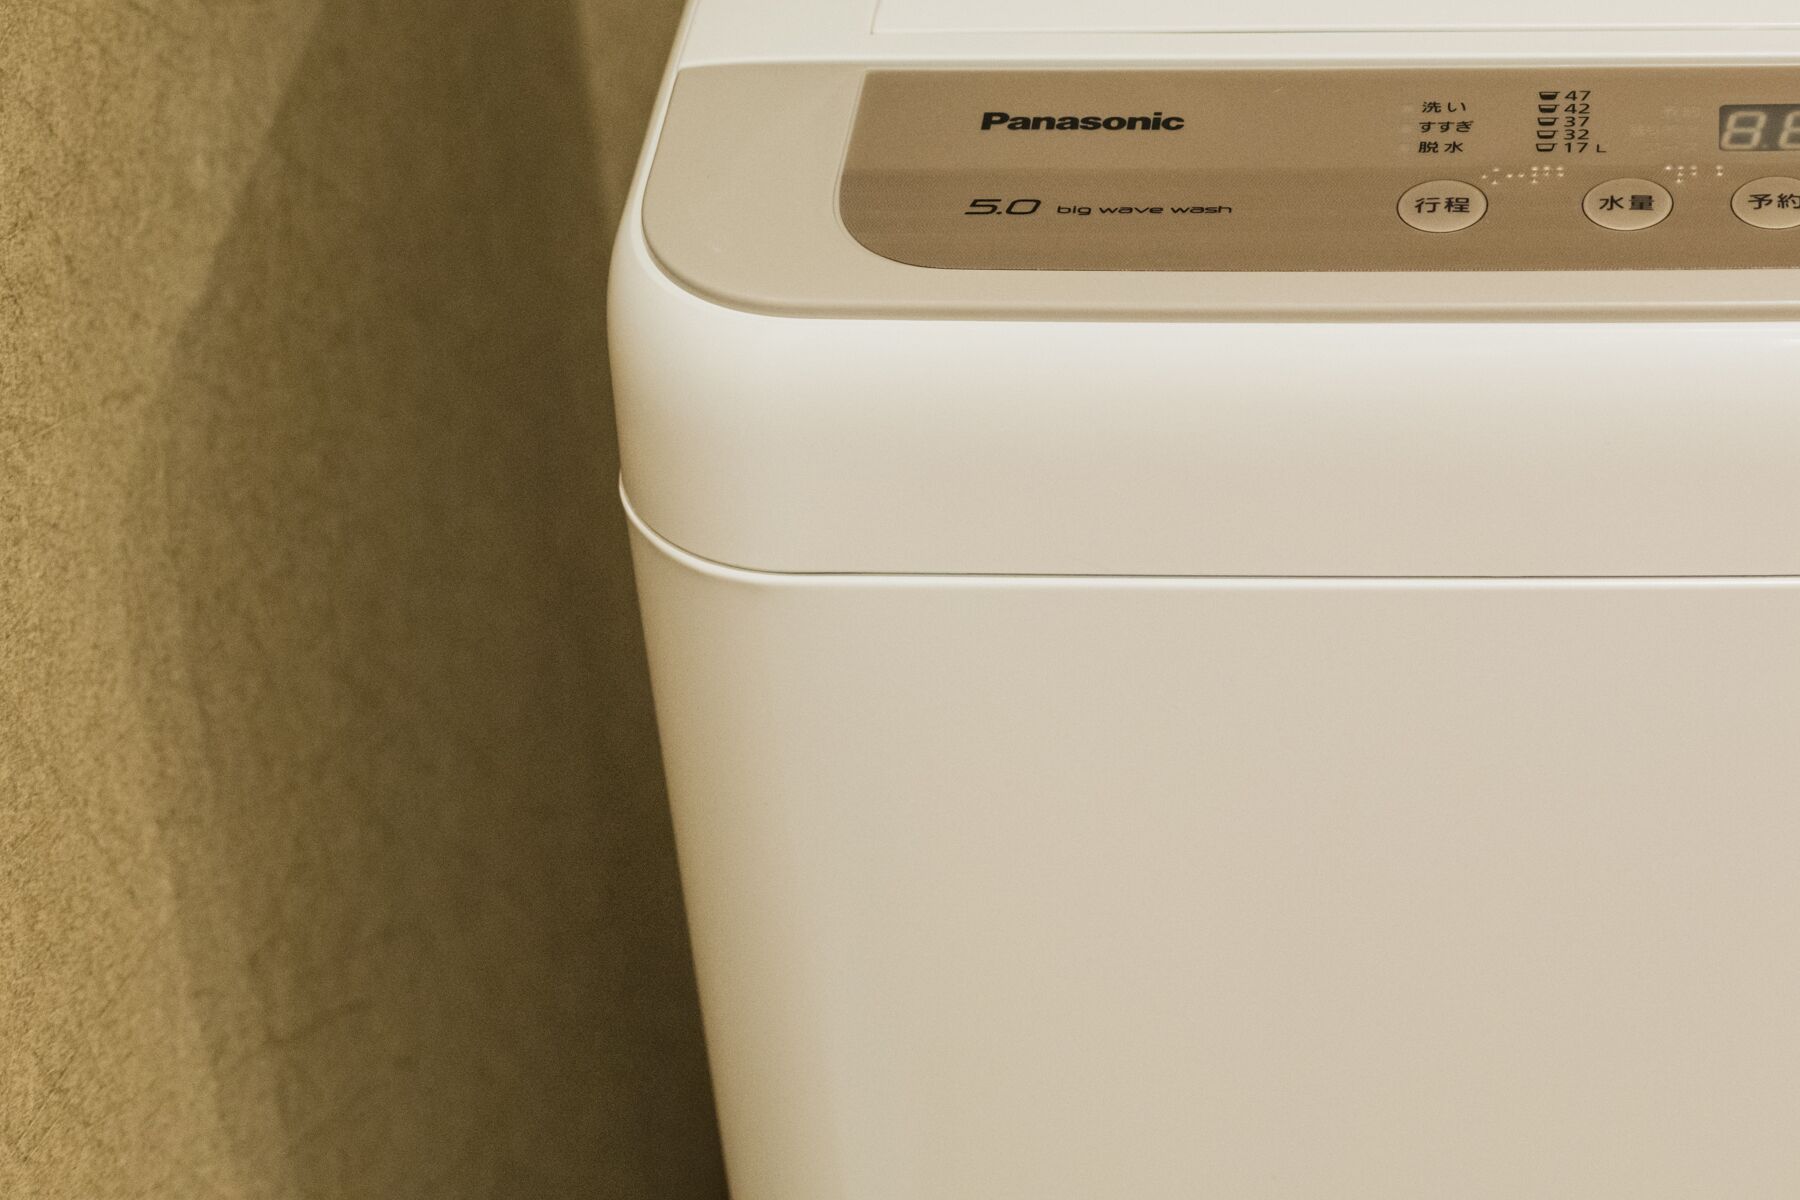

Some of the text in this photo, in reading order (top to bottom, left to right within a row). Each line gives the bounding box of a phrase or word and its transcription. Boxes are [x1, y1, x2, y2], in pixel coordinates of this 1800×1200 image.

[1564, 90, 1591, 101] 47
[1421, 101, 1467, 113] 洗い
[1564, 103, 1591, 114] 42
[980, 111, 1185, 131] Panasonic
[1418, 120, 1474, 133] すすぎ
[1564, 116, 1590, 127] 37
[1563, 129, 1590, 140] 32
[1418, 140, 1464, 153] 脱水
[1564, 142, 1589, 153] 17
[964, 198, 1233, 216] 5.0 big wave wash
[1414, 196, 1471, 214] 行程
[1599, 194, 1655, 211] 水量
